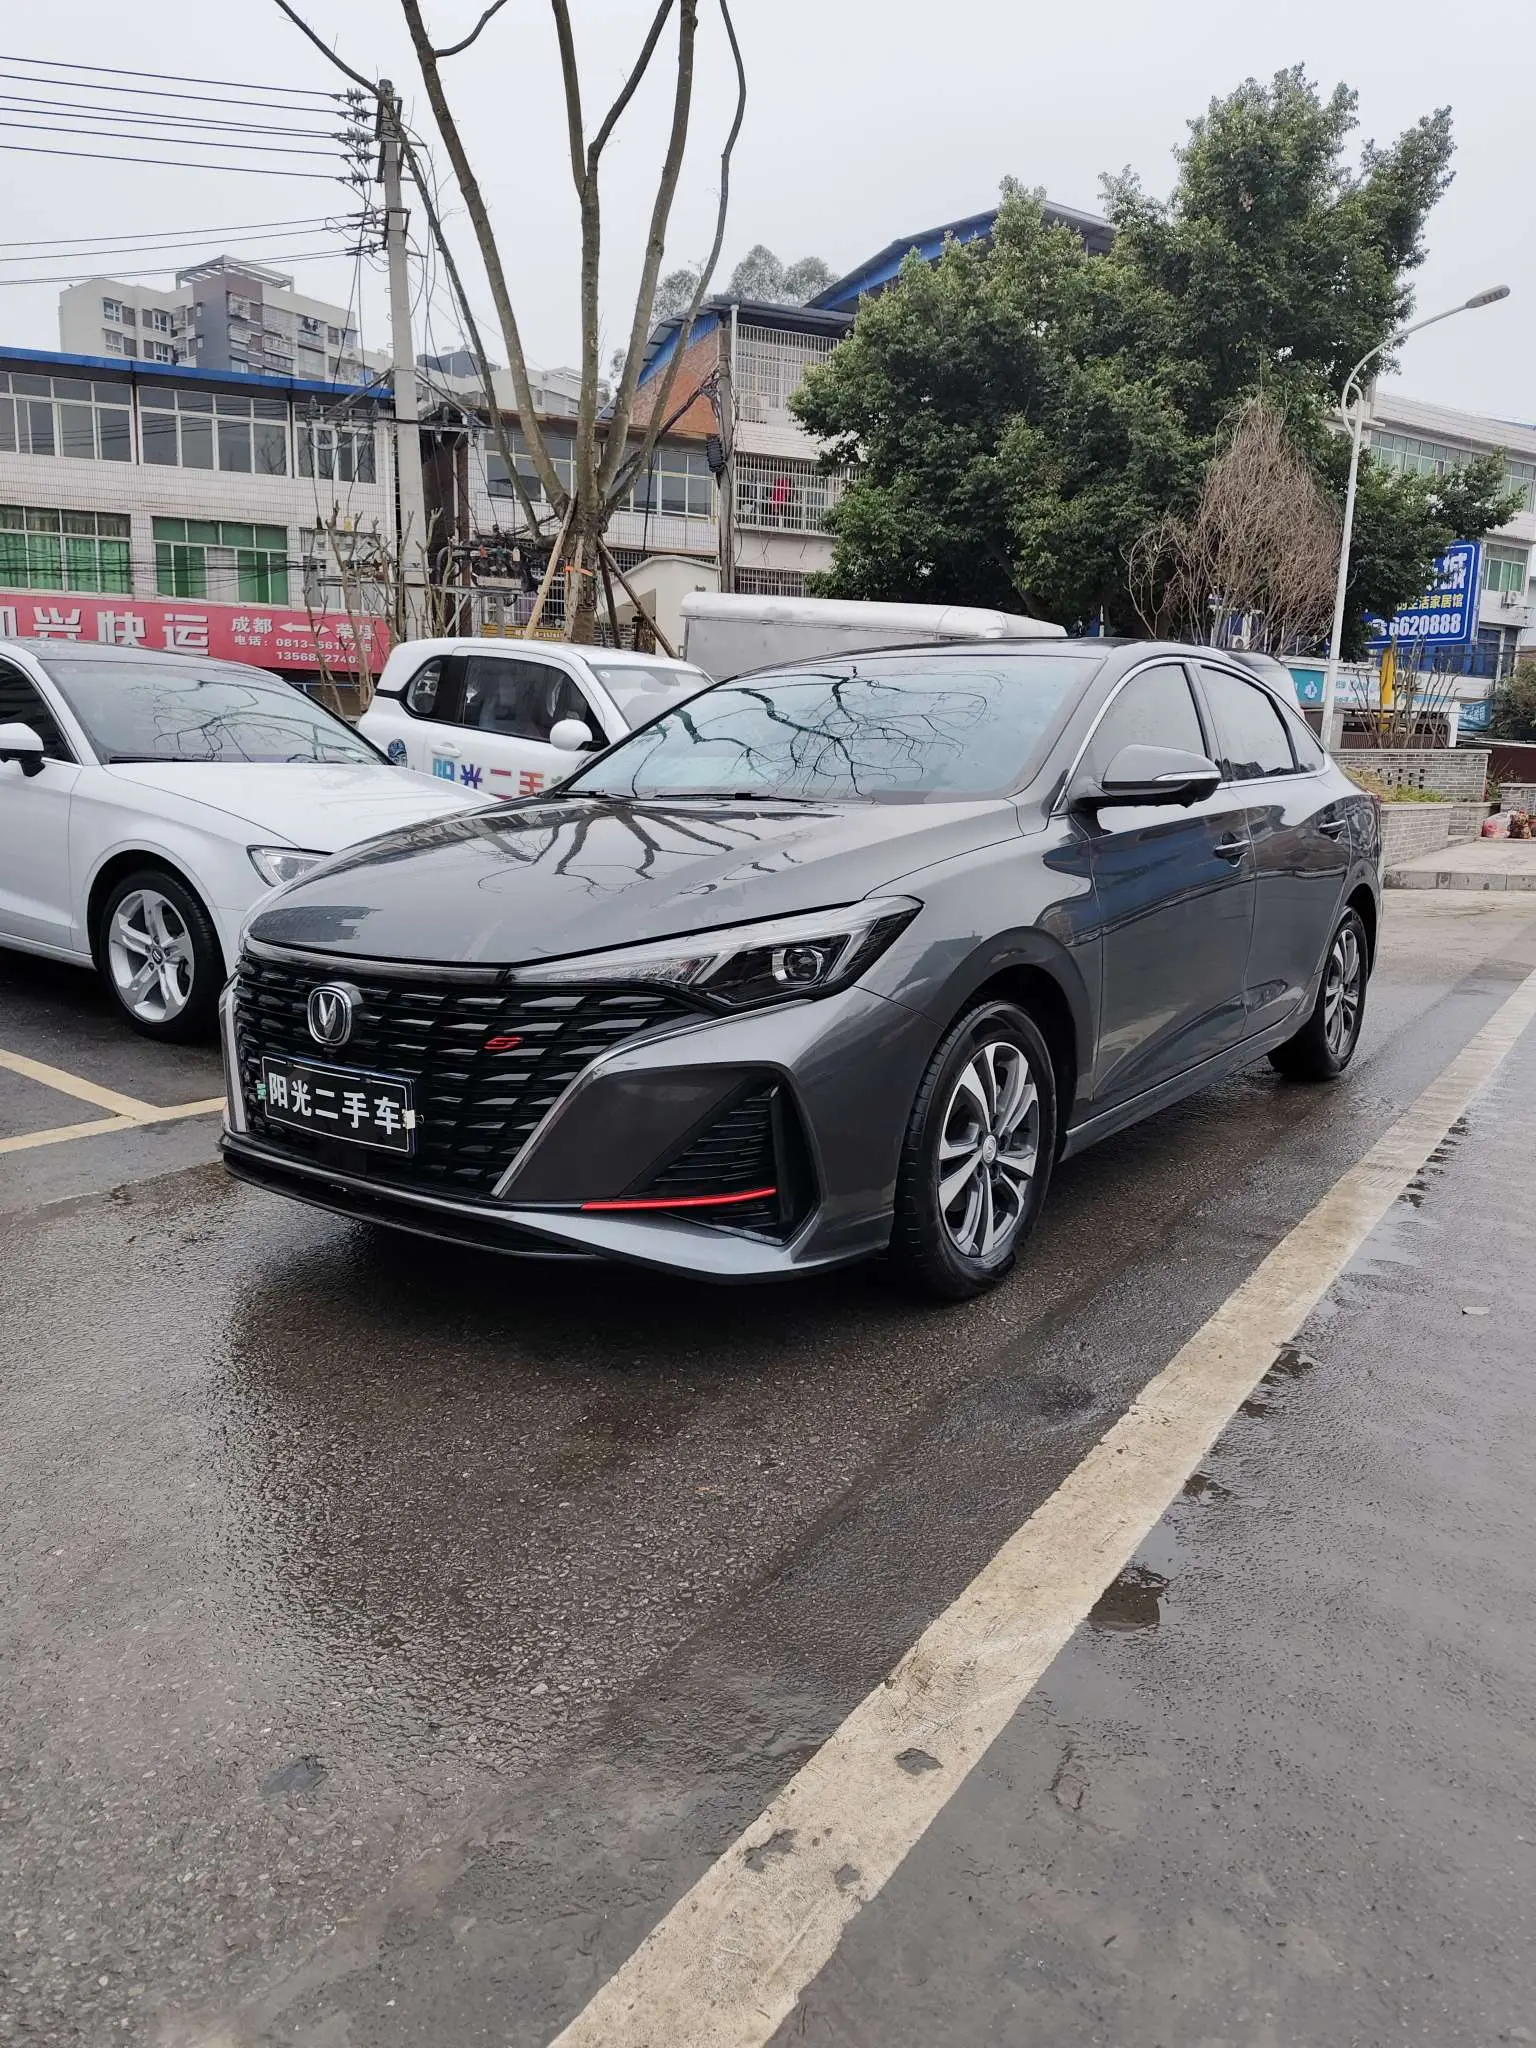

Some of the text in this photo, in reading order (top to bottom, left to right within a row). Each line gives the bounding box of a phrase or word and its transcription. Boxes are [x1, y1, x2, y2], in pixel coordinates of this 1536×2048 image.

[231, 617, 273, 634] 成都
[1389, 613, 1461, 636] 6620888
[268, 1072, 401, 1134] 阳光二手车
